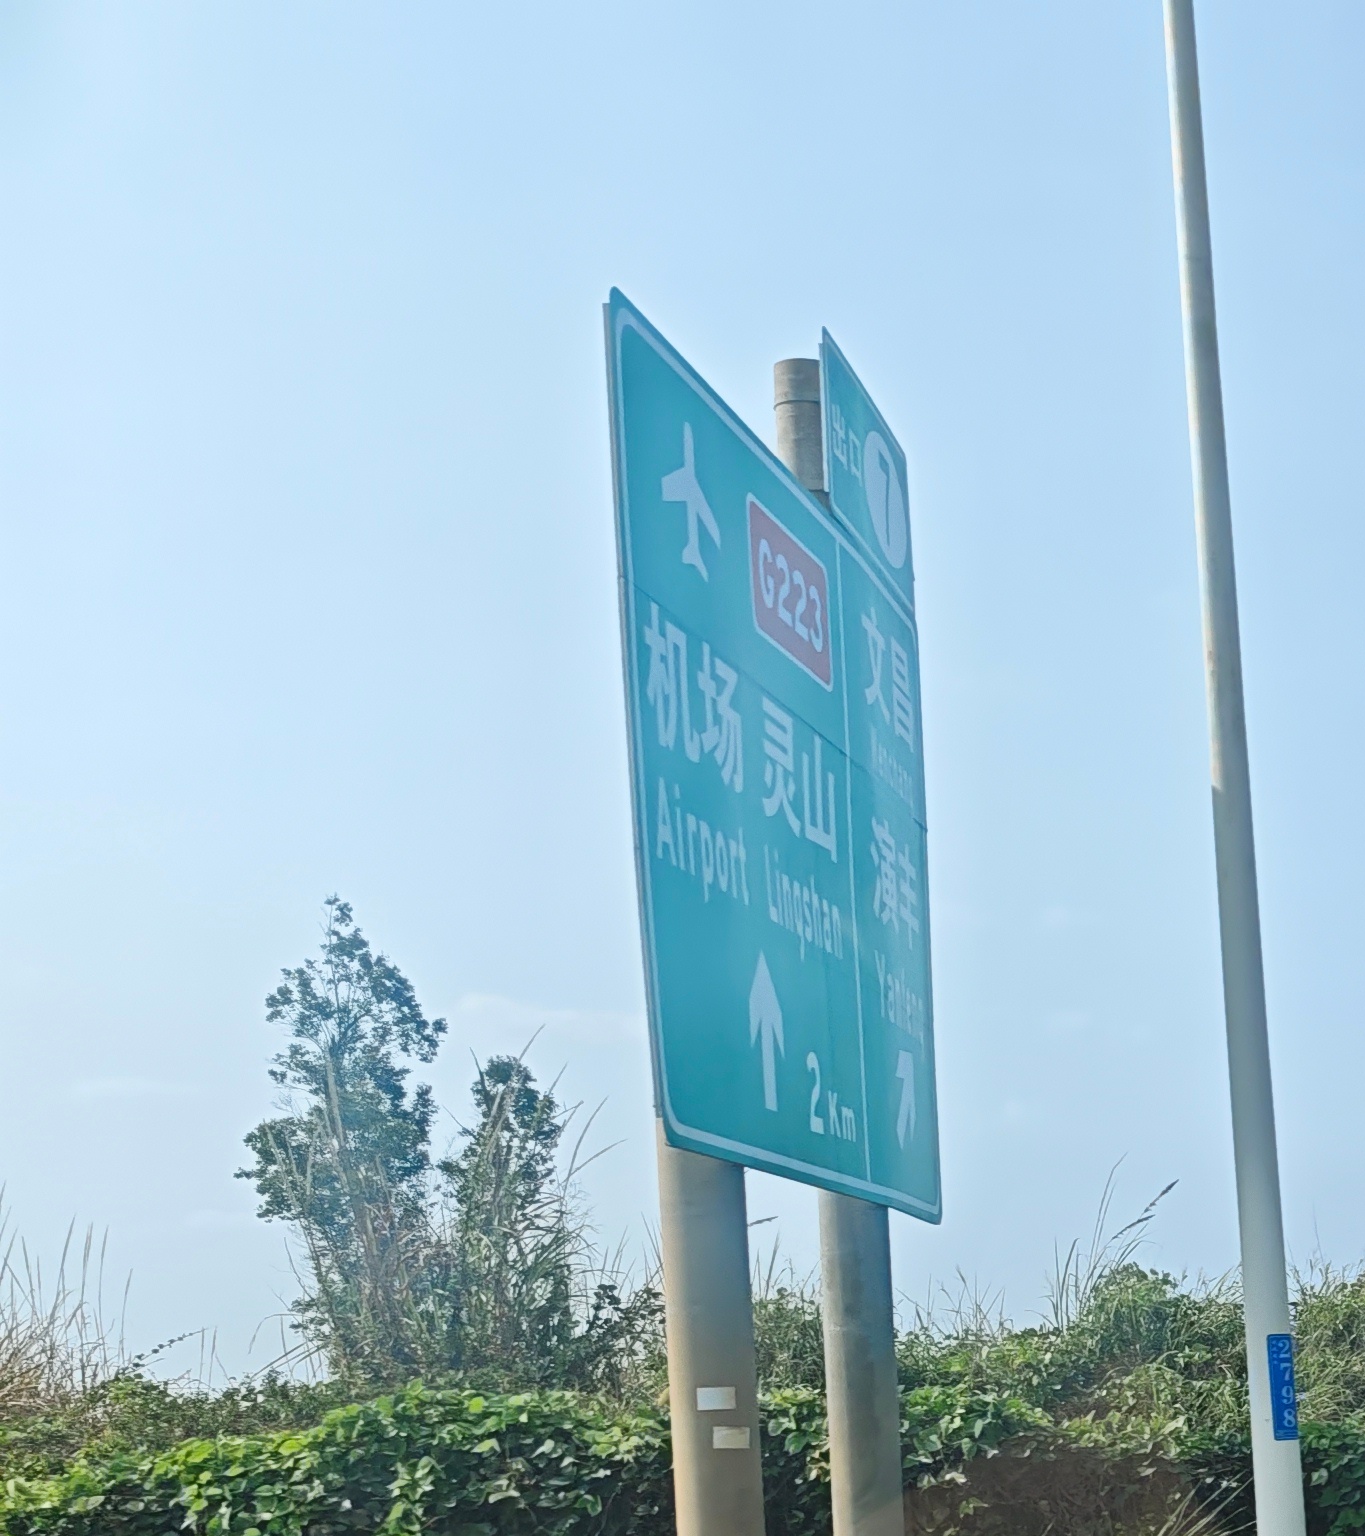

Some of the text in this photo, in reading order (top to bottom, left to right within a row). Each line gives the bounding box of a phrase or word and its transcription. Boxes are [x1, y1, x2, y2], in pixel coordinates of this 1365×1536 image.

[832, 404, 892, 548] 出口 7
[758, 537, 824, 654] G223
[644, 600, 839, 864] 机场 灵山
[861, 605, 915, 754] 文昌
[656, 776, 845, 963] Airport Lingshan
[870, 815, 920, 950] 演丰
[806, 1050, 825, 1135] 2
[1279, 1339, 1296, 1428] 2798
